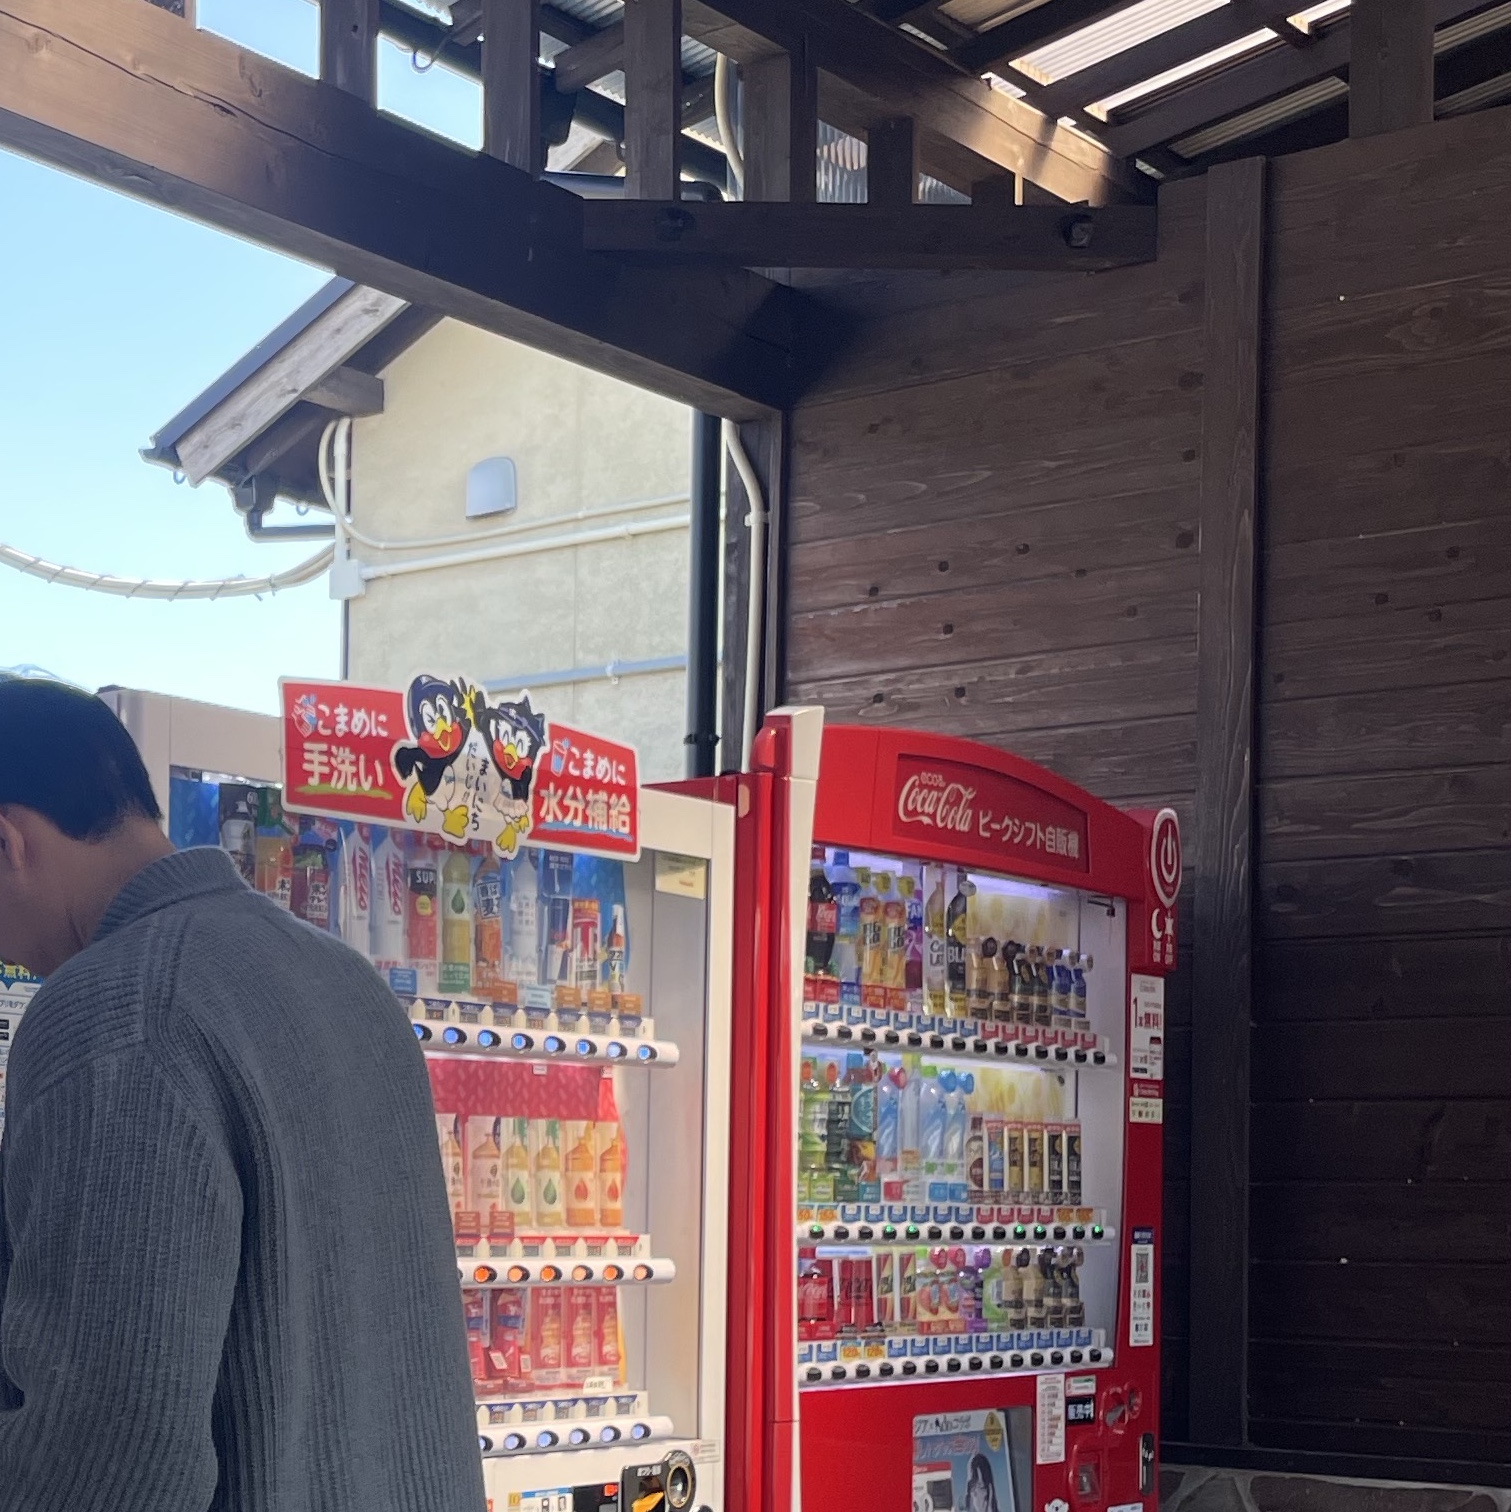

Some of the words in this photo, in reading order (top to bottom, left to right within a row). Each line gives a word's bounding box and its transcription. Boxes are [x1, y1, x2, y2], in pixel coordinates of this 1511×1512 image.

[316, 703, 389, 739] こまめに
[301, 741, 384, 792] 手洗い
[568, 746, 626, 786] こまめに
[471, 757, 489, 832] まいにち
[539, 788, 631, 835] 水分補給
[897, 774, 976, 833] Coca-Cola
